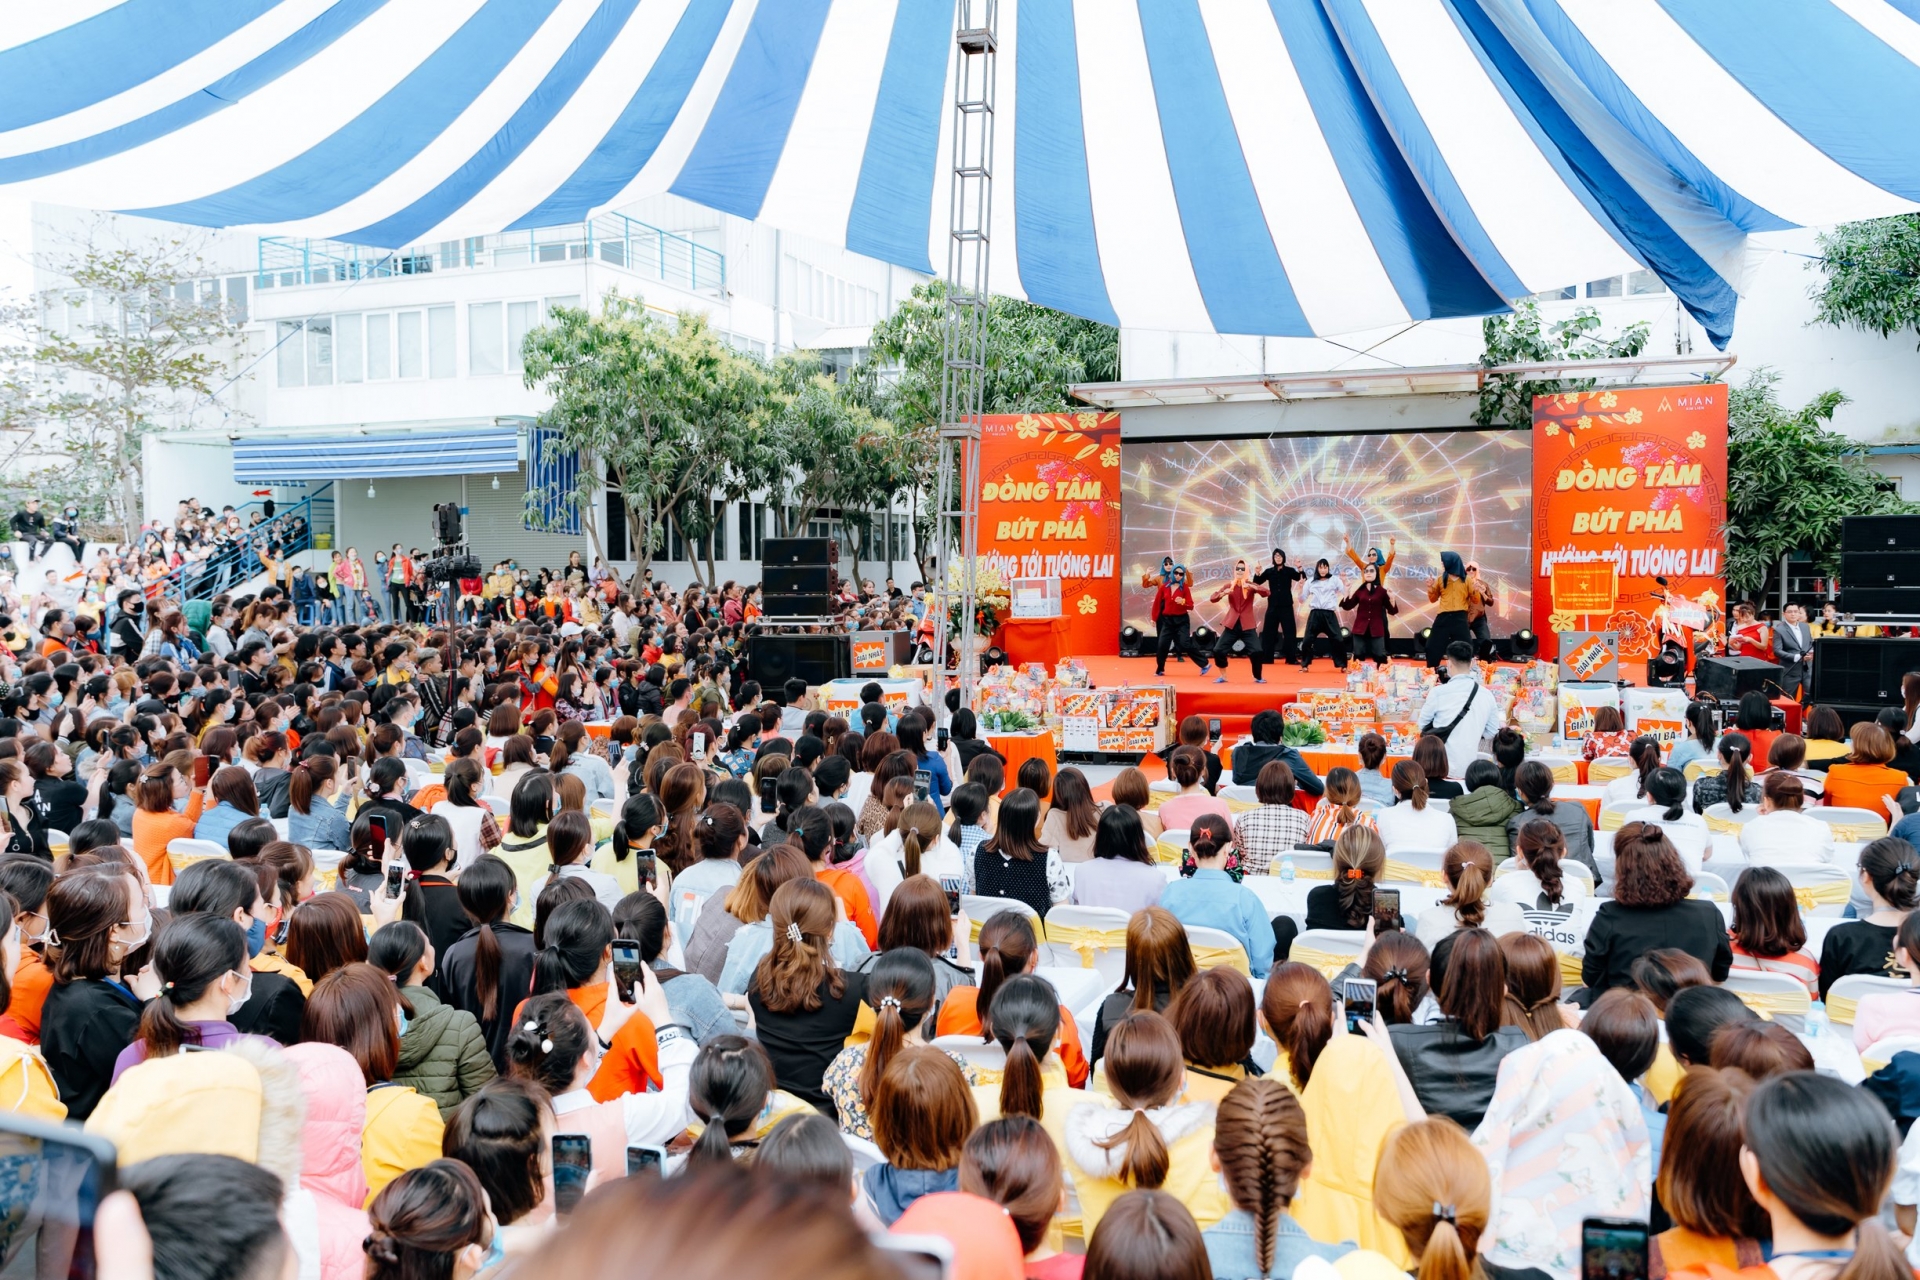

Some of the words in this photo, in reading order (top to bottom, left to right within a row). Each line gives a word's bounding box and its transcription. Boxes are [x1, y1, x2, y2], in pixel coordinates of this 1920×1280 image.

[1678, 396, 1713, 406] MIAN
[985, 424, 1014, 432] MIAN
[1555, 458, 1638, 491] ĐỒNG
[1643, 460, 1702, 488] TÂM
[981, 473, 1051, 502] ĐỒNG
[1055, 476, 1102, 501] TÂM
[1412, 494, 1441, 506] GOT
[995, 515, 1039, 540] BỨT
[1041, 515, 1088, 540] PHÁ
[1571, 505, 1624, 533] BỨT
[1627, 503, 1684, 532] PHÁ
[981, 548, 1019, 579] ƯỚNG
[1021, 548, 1042, 578] TỚI
[1045, 550, 1091, 578] TƯƠNG
[1092, 554, 1115, 578] LAI
[1630, 544, 1687, 575] TƯƠNG
[1690, 549, 1718, 575] LAI
[1406, 566, 1438, 581] BẠN
[1664, 731, 1676, 741] BA
[1527, 927, 1576, 945] didas
